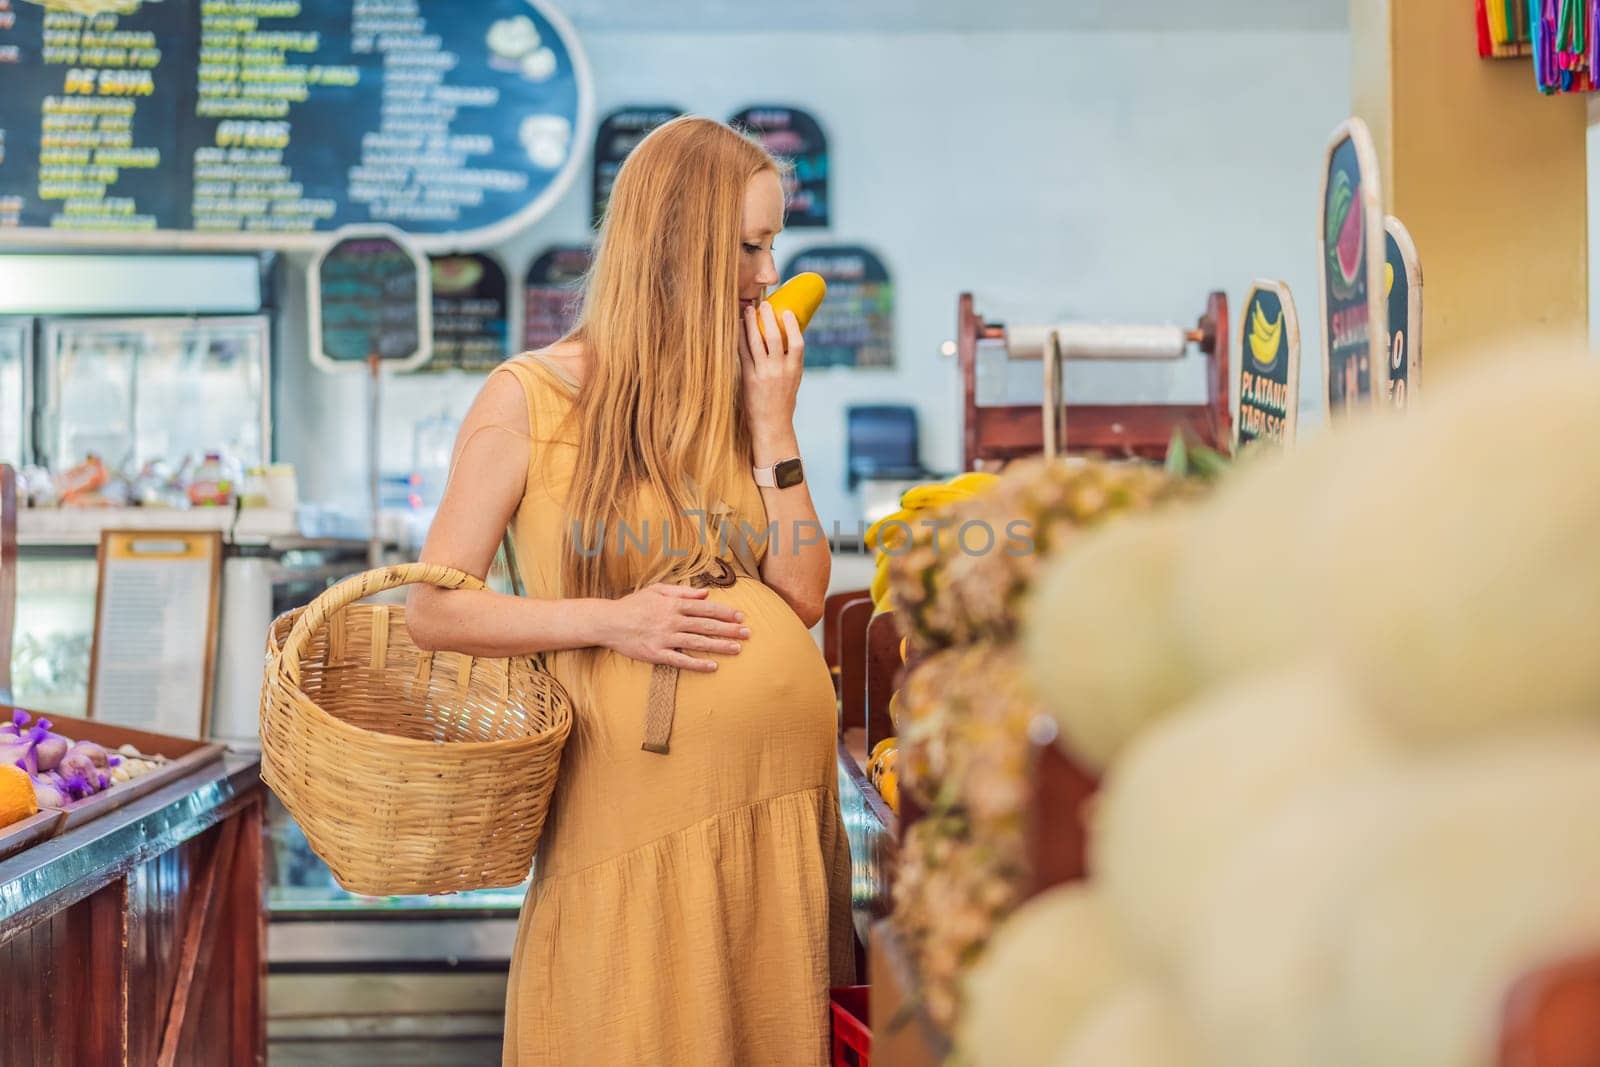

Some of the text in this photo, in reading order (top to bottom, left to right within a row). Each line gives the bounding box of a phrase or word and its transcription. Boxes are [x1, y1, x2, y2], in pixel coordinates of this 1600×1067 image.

[64, 68, 98, 94] DE
[1242, 371, 1288, 411] PLATANO
[1241, 404, 1287, 441] TABASCO
